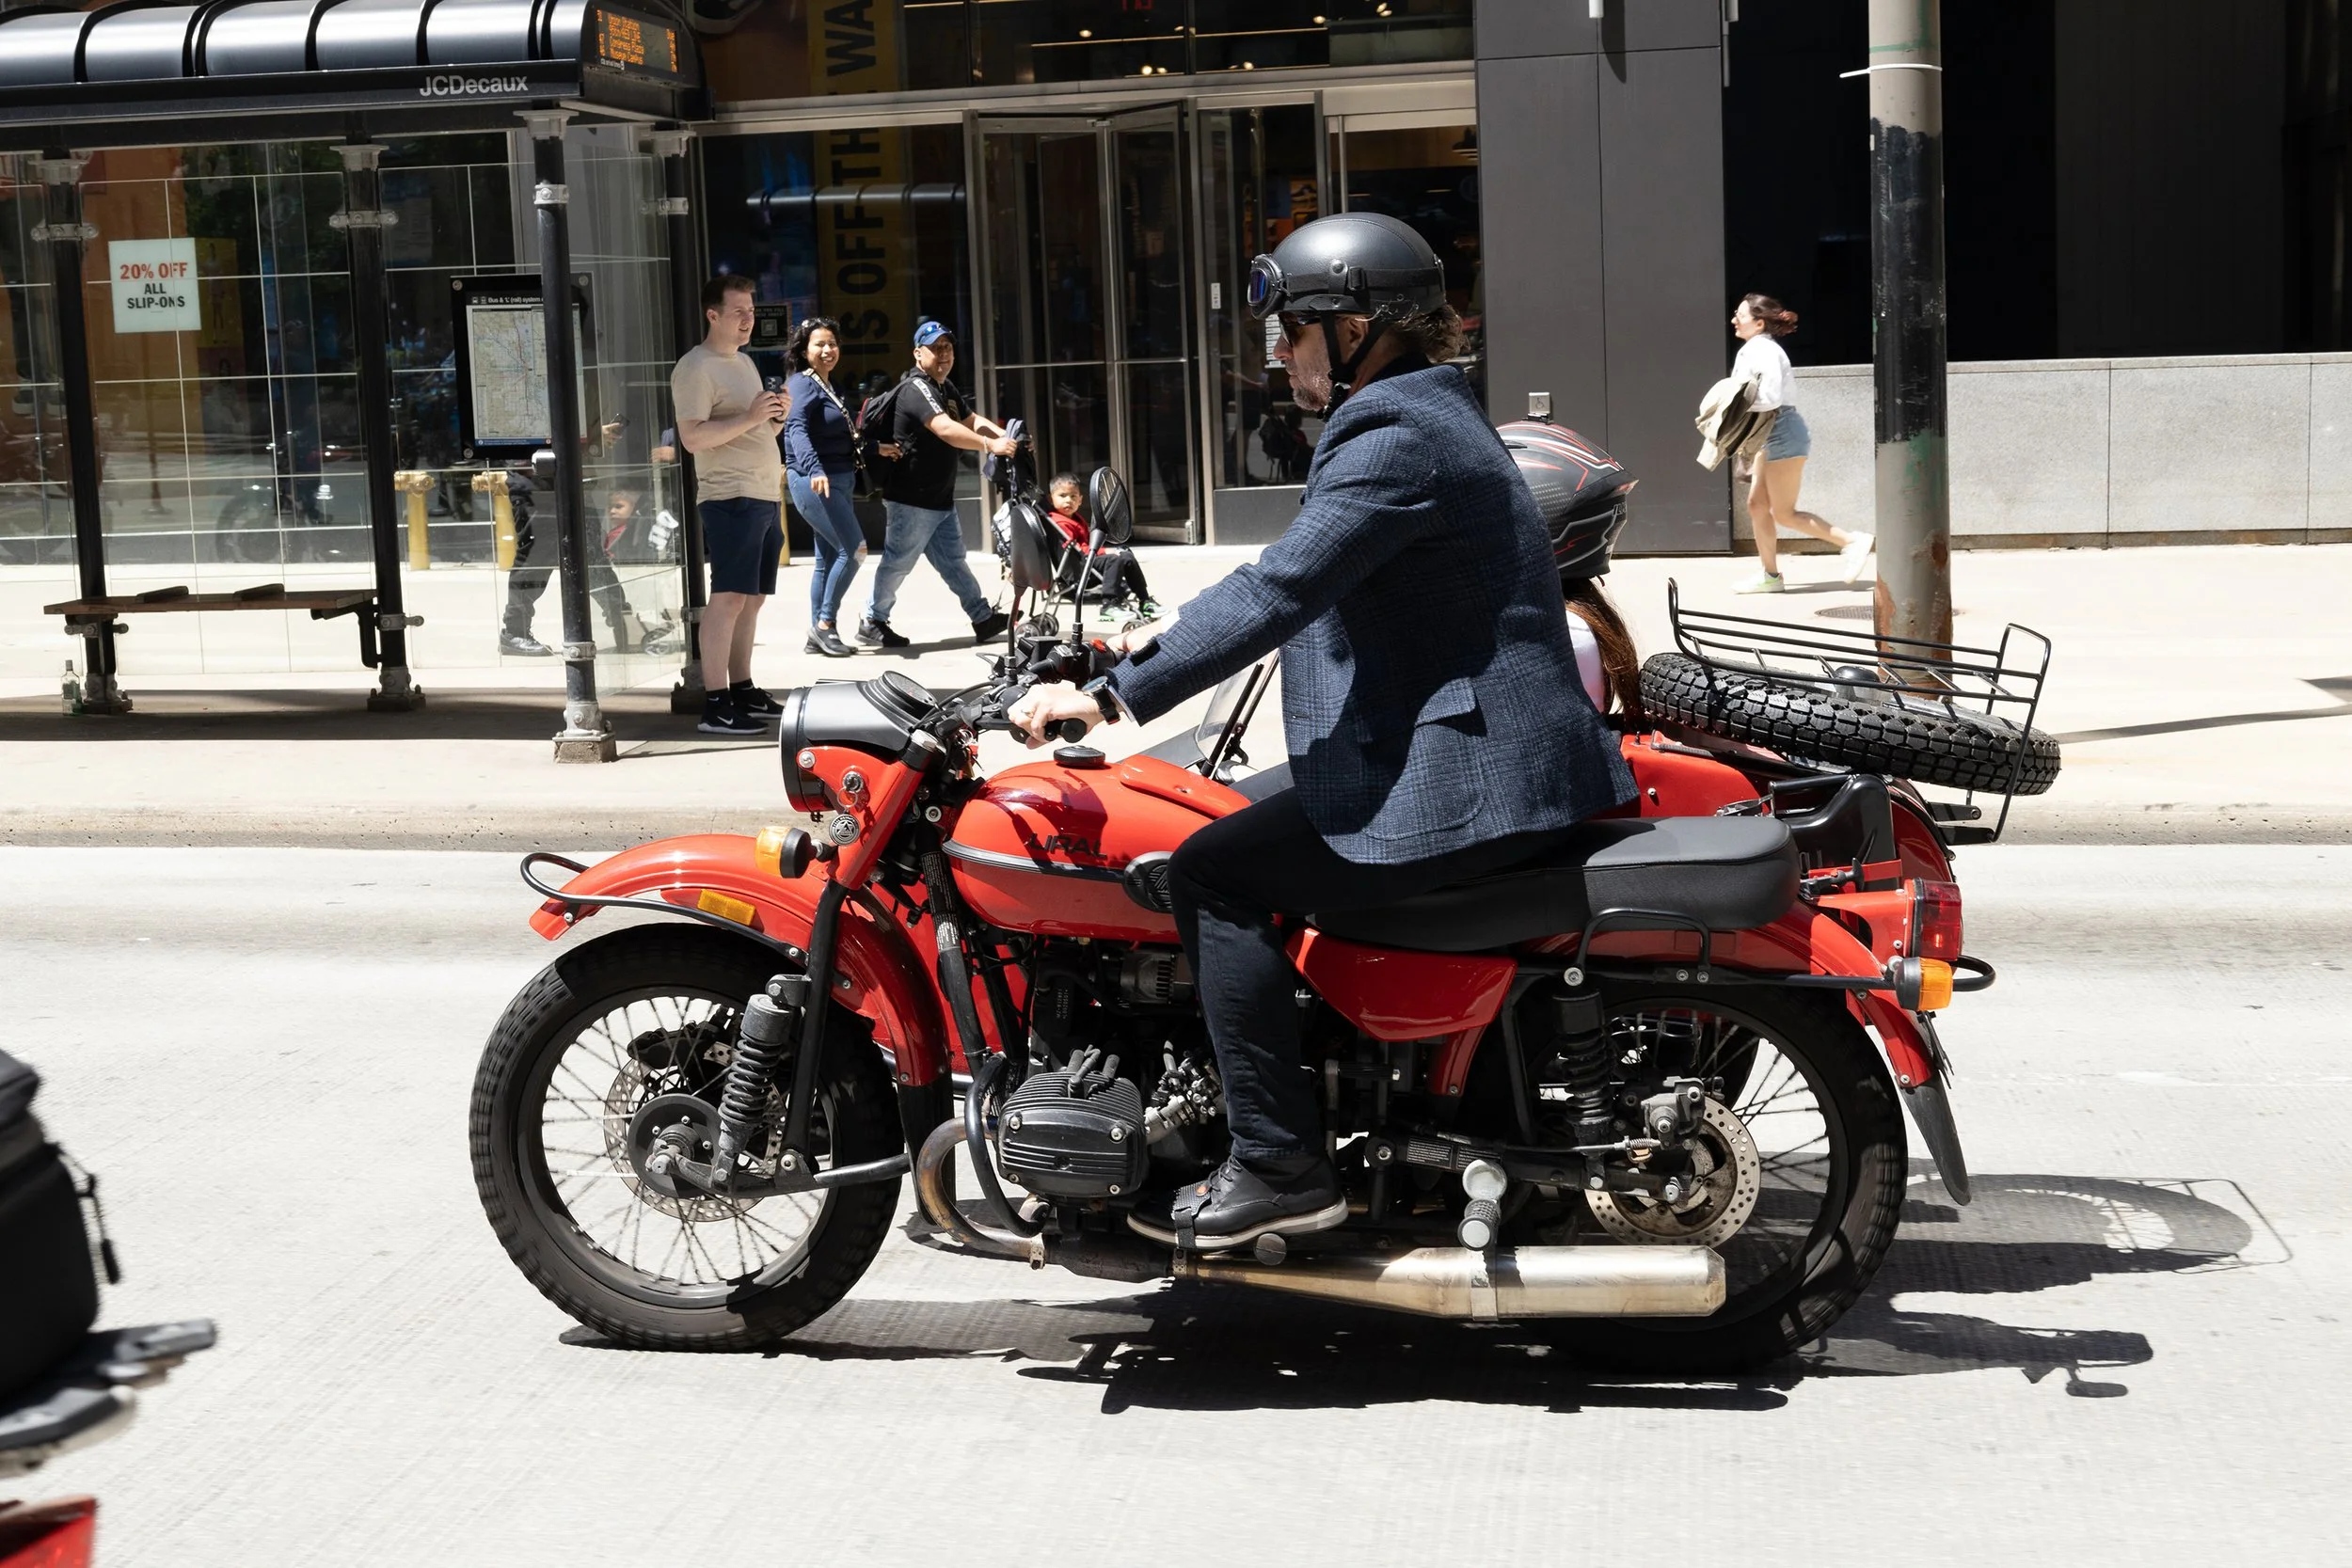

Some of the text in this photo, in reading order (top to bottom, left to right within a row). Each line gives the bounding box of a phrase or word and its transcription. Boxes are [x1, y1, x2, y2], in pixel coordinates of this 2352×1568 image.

[420, 75, 529, 97] JCDecaux
[833, 200, 888, 295] OFF
[119, 261, 188, 279] 20% OFF
[144, 283, 167, 294] ALL
[127, 295, 185, 309] SLIP-ONS
[1027, 832, 1107, 860] URAL
